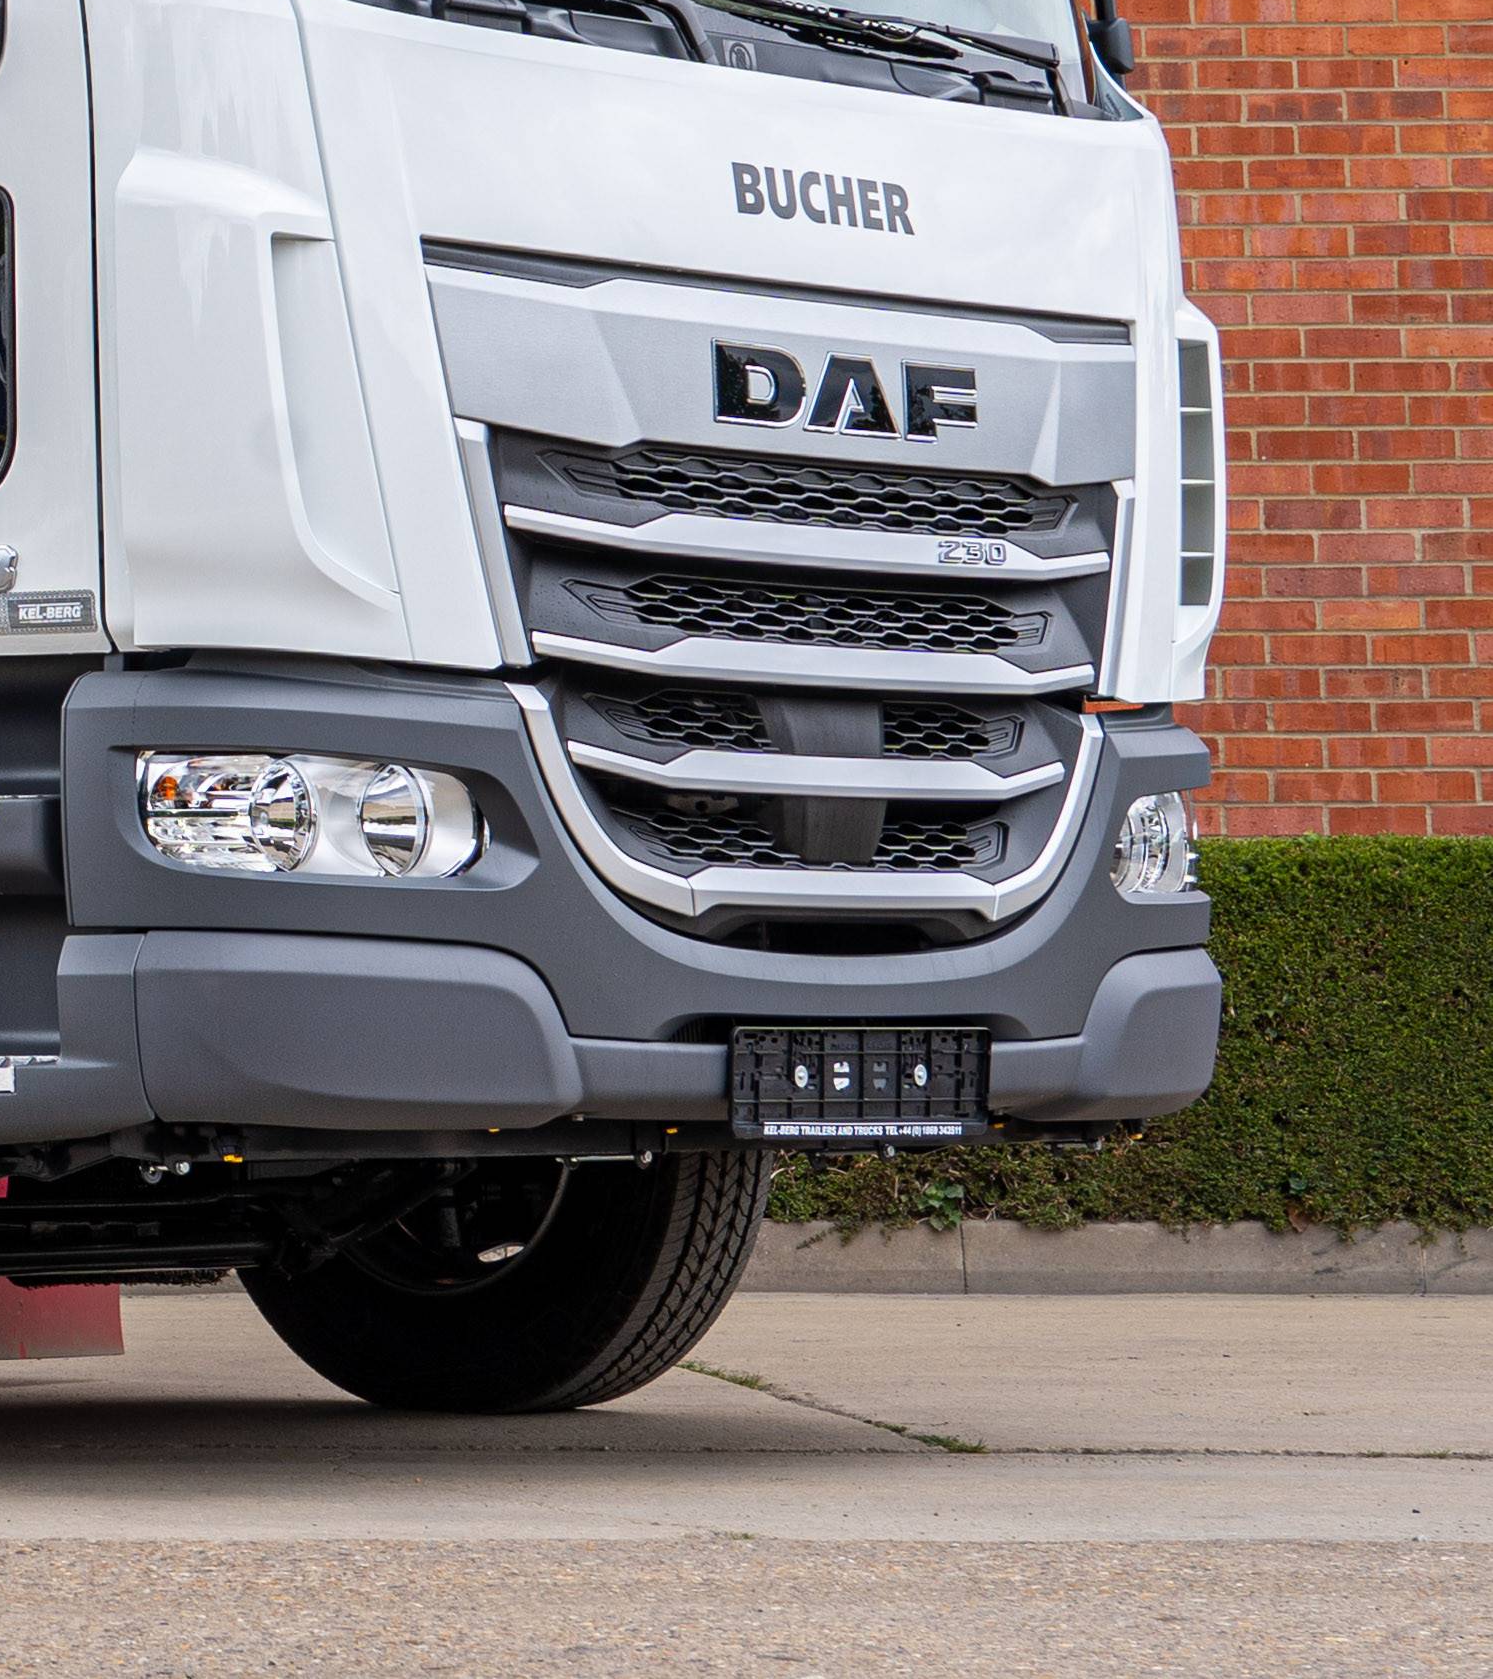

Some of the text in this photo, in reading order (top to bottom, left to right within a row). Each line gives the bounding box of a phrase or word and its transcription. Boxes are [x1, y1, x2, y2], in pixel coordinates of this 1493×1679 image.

[730, 161, 914, 235] BUCHER
[711, 338, 978, 442] DAF
[937, 539, 1009, 567] 230
[19, 604, 82, 621] KEL-BERG
[763, 1125, 799, 1136] KEL-BERG
[800, 1125, 836, 1136] TRAILERS
[837, 1125, 853, 1136] AND
[854, 1125, 883, 1136] TRUCKS
